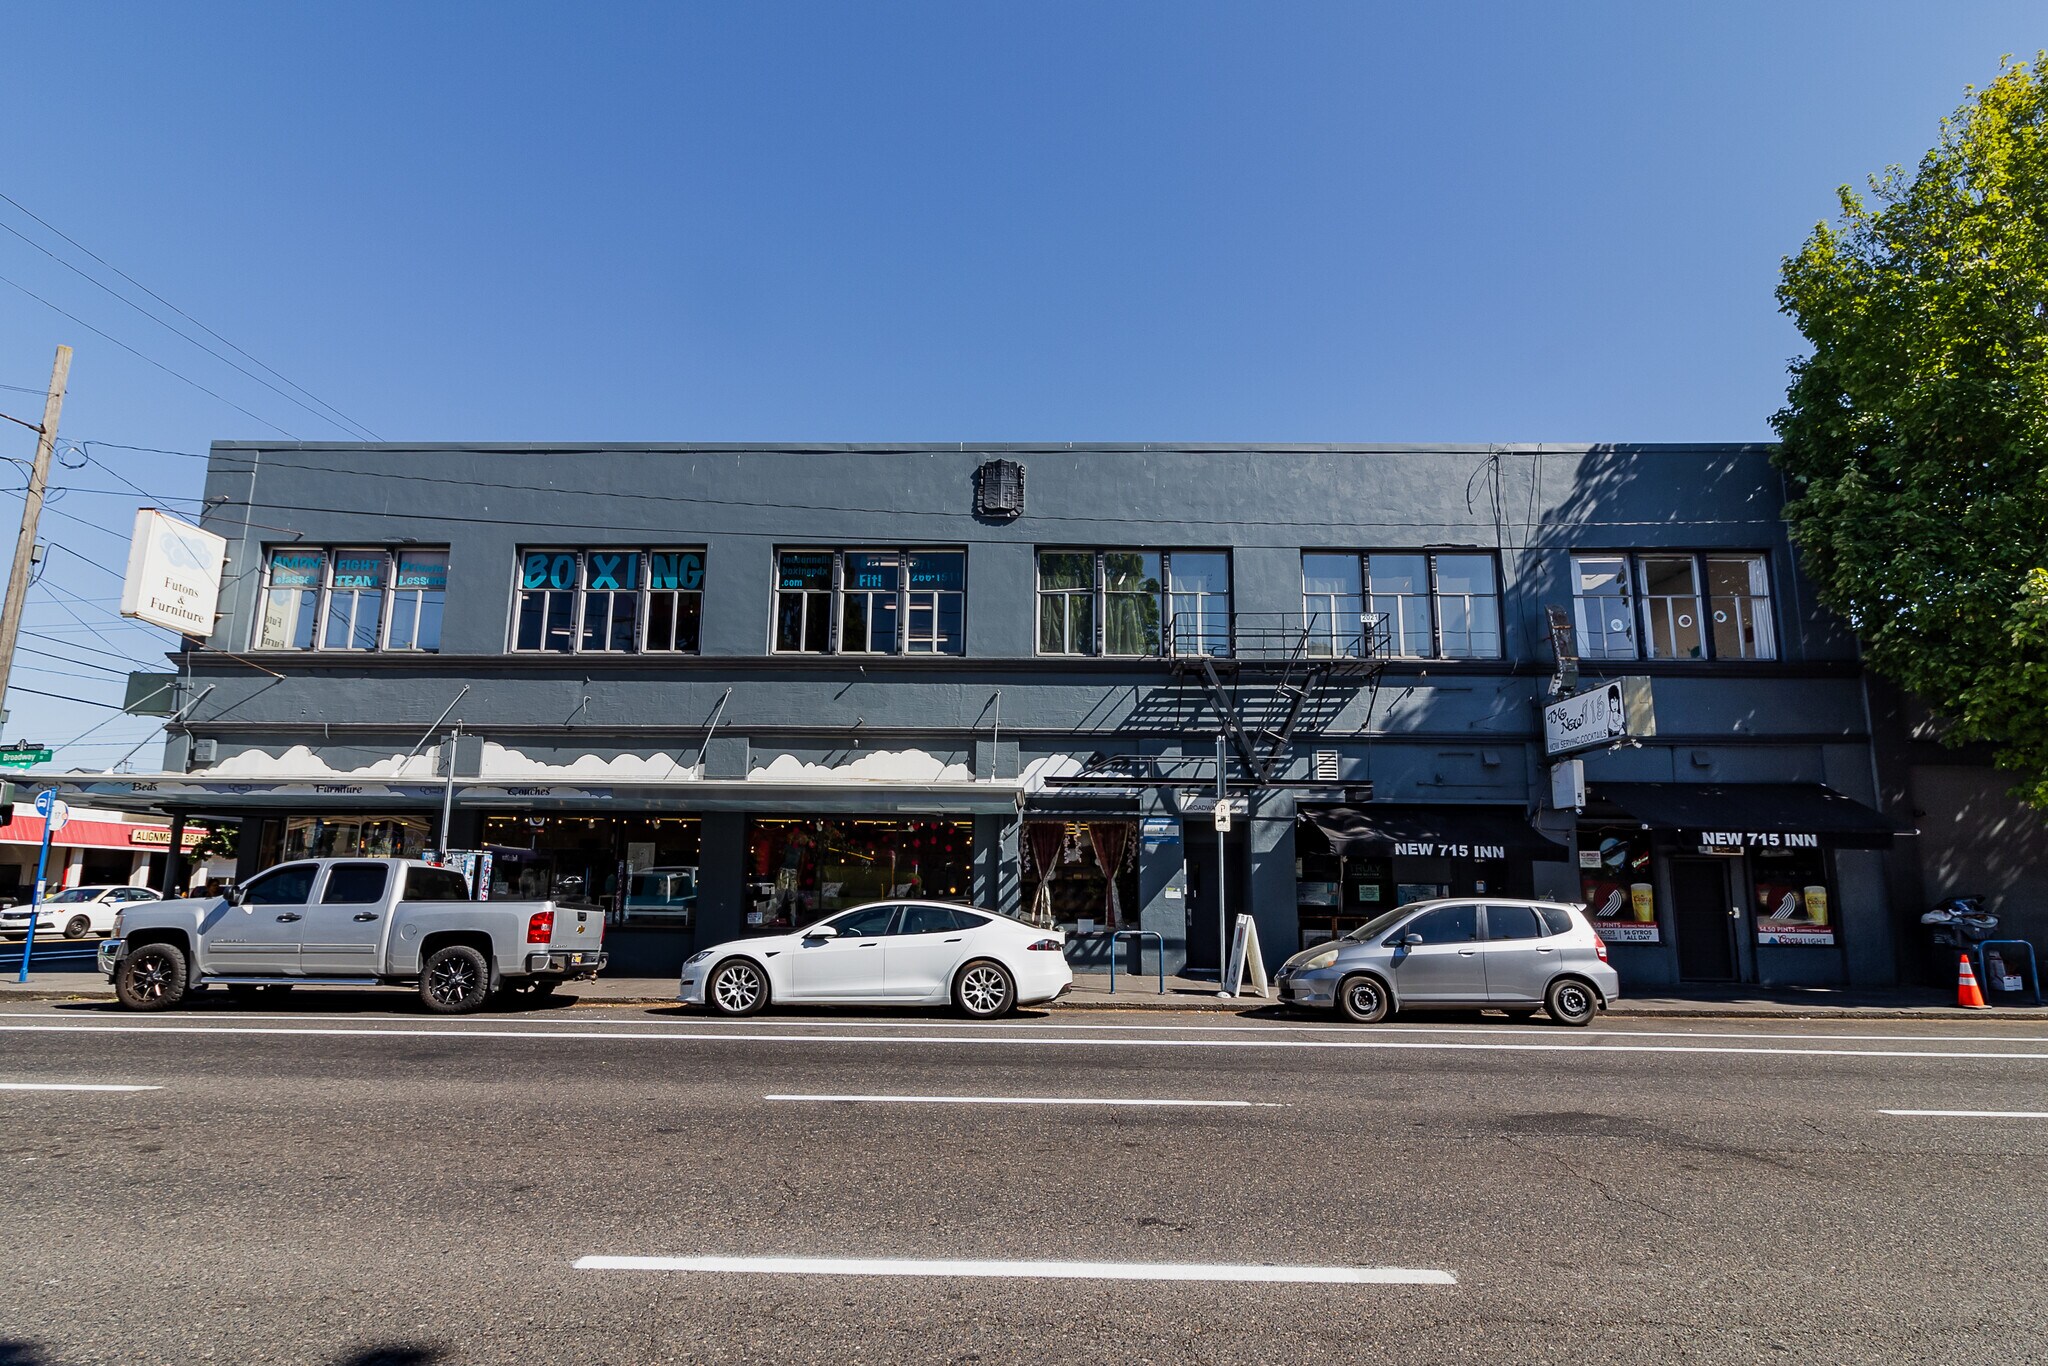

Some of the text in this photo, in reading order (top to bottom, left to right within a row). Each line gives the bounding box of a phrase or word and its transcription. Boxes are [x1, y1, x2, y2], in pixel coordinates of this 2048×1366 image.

[337, 559, 381, 571] FIGHT
[523, 553, 704, 590] BOXING
[335, 576, 378, 587] TEAM
[781, 578, 802, 587] .com
[859, 574, 882, 587] Fit!
[164, 576, 199, 598] Futons
[177, 595, 185, 605] &
[150, 597, 204, 623] Furniture
[1362, 613, 1378, 621] 2021
[1560, 736, 1580, 749] SERVING
[1581, 729, 1607, 743] COCKTAILS
[3, 753, 36, 762] Broadway
[131, 782, 158, 792] Beds
[314, 783, 363, 795] Furniture
[507, 786, 550, 796] Couches
[136, 831, 170, 842] ALIGNME
[1702, 832, 1817, 847] NEW 715 INN
[1395, 843, 1504, 858] NEW 715 INN
[1778, 934, 1803, 944] Coors
